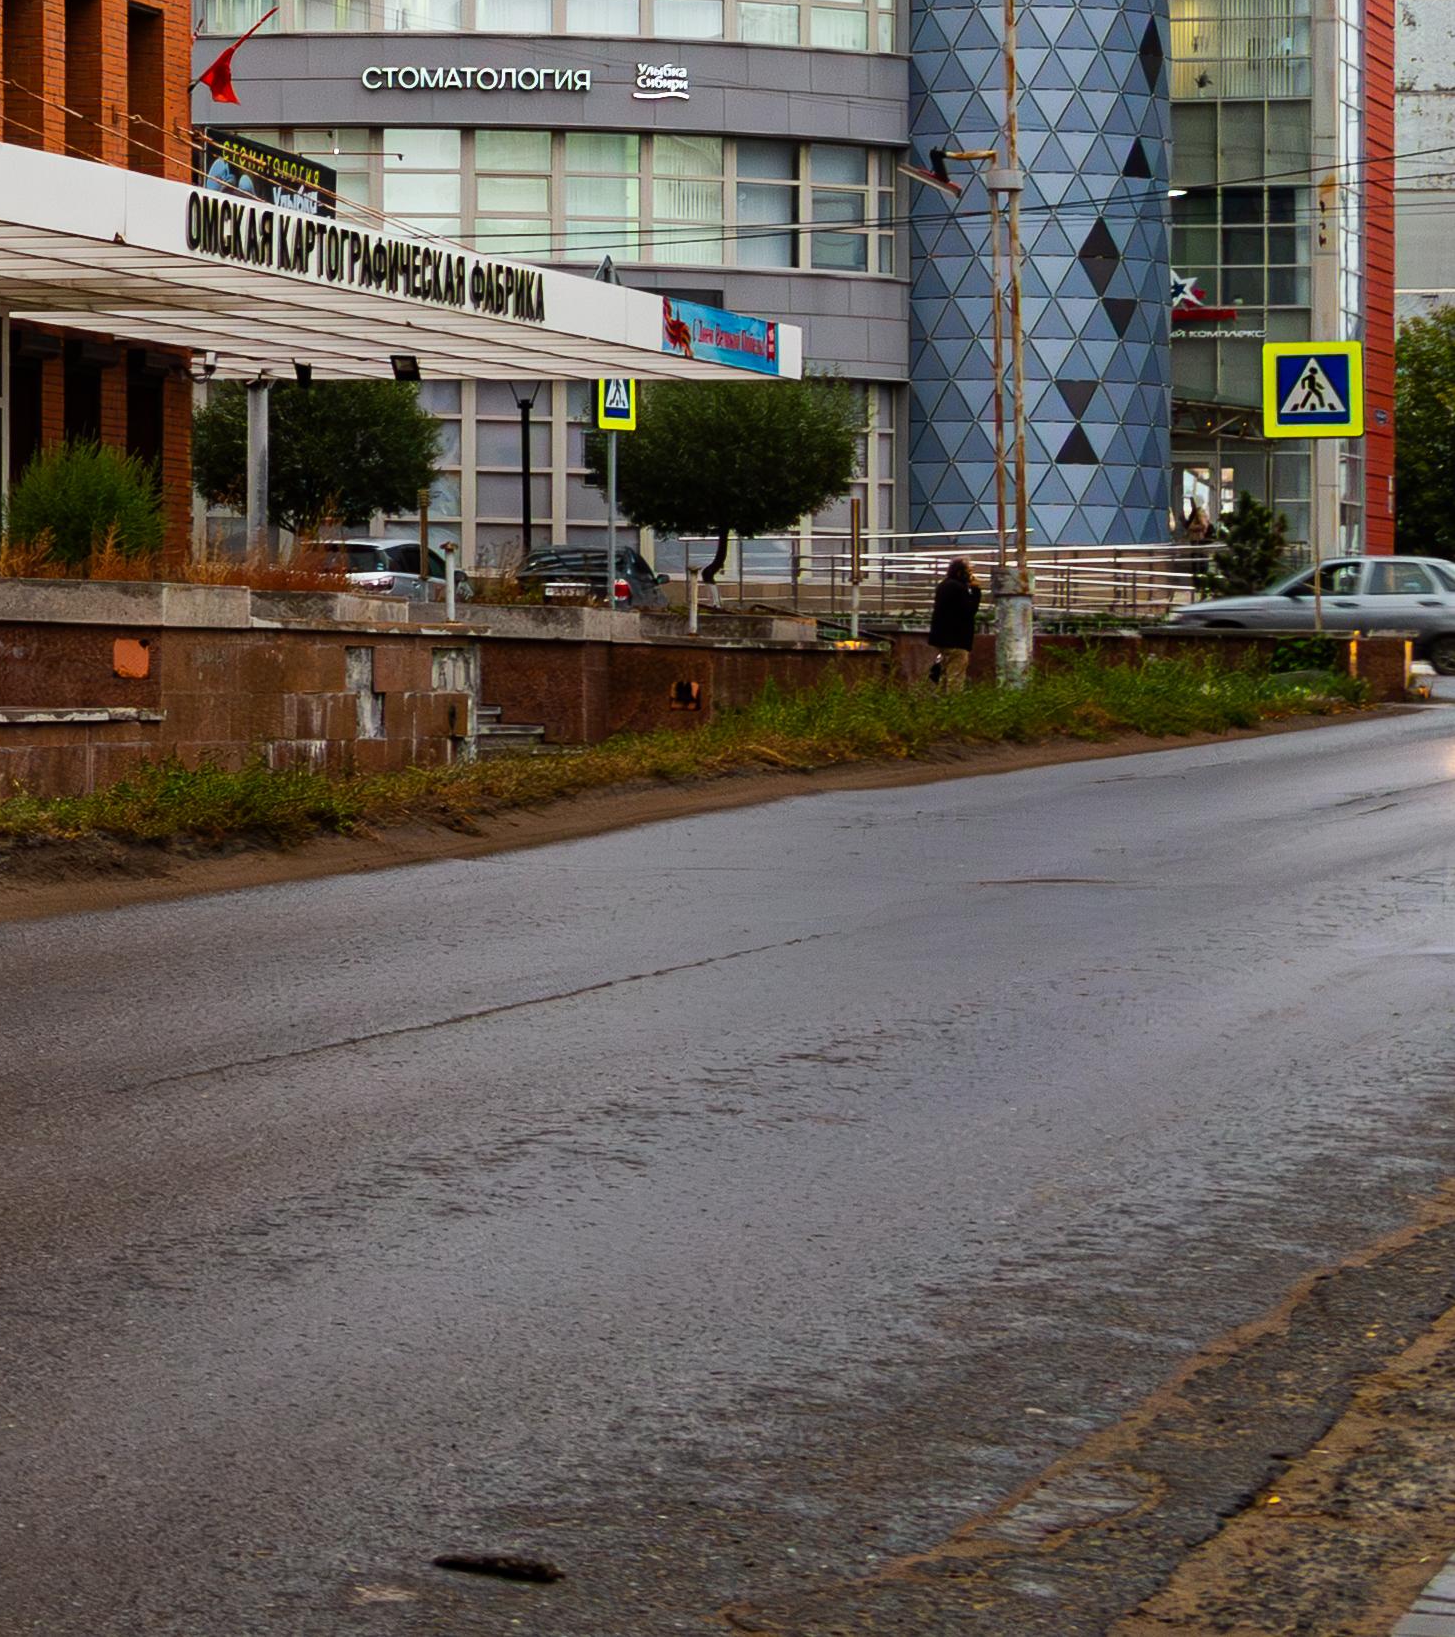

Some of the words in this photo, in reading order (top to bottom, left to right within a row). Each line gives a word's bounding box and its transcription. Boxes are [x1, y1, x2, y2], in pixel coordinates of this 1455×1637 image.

[361, 66, 591, 91] СТОМАТОЛОГИЯ
[637, 63, 688, 78] Улыбка
[636, 75, 689, 92] Сибири
[221, 140, 321, 187] СТОМАТОЛОГИЯ
[186, 190, 274, 267] ОМСКАЯ
[276, 214, 467, 307] КАРТОГРАФИЧЕСКАЯ
[470, 260, 546, 322] ФАБРИКА
